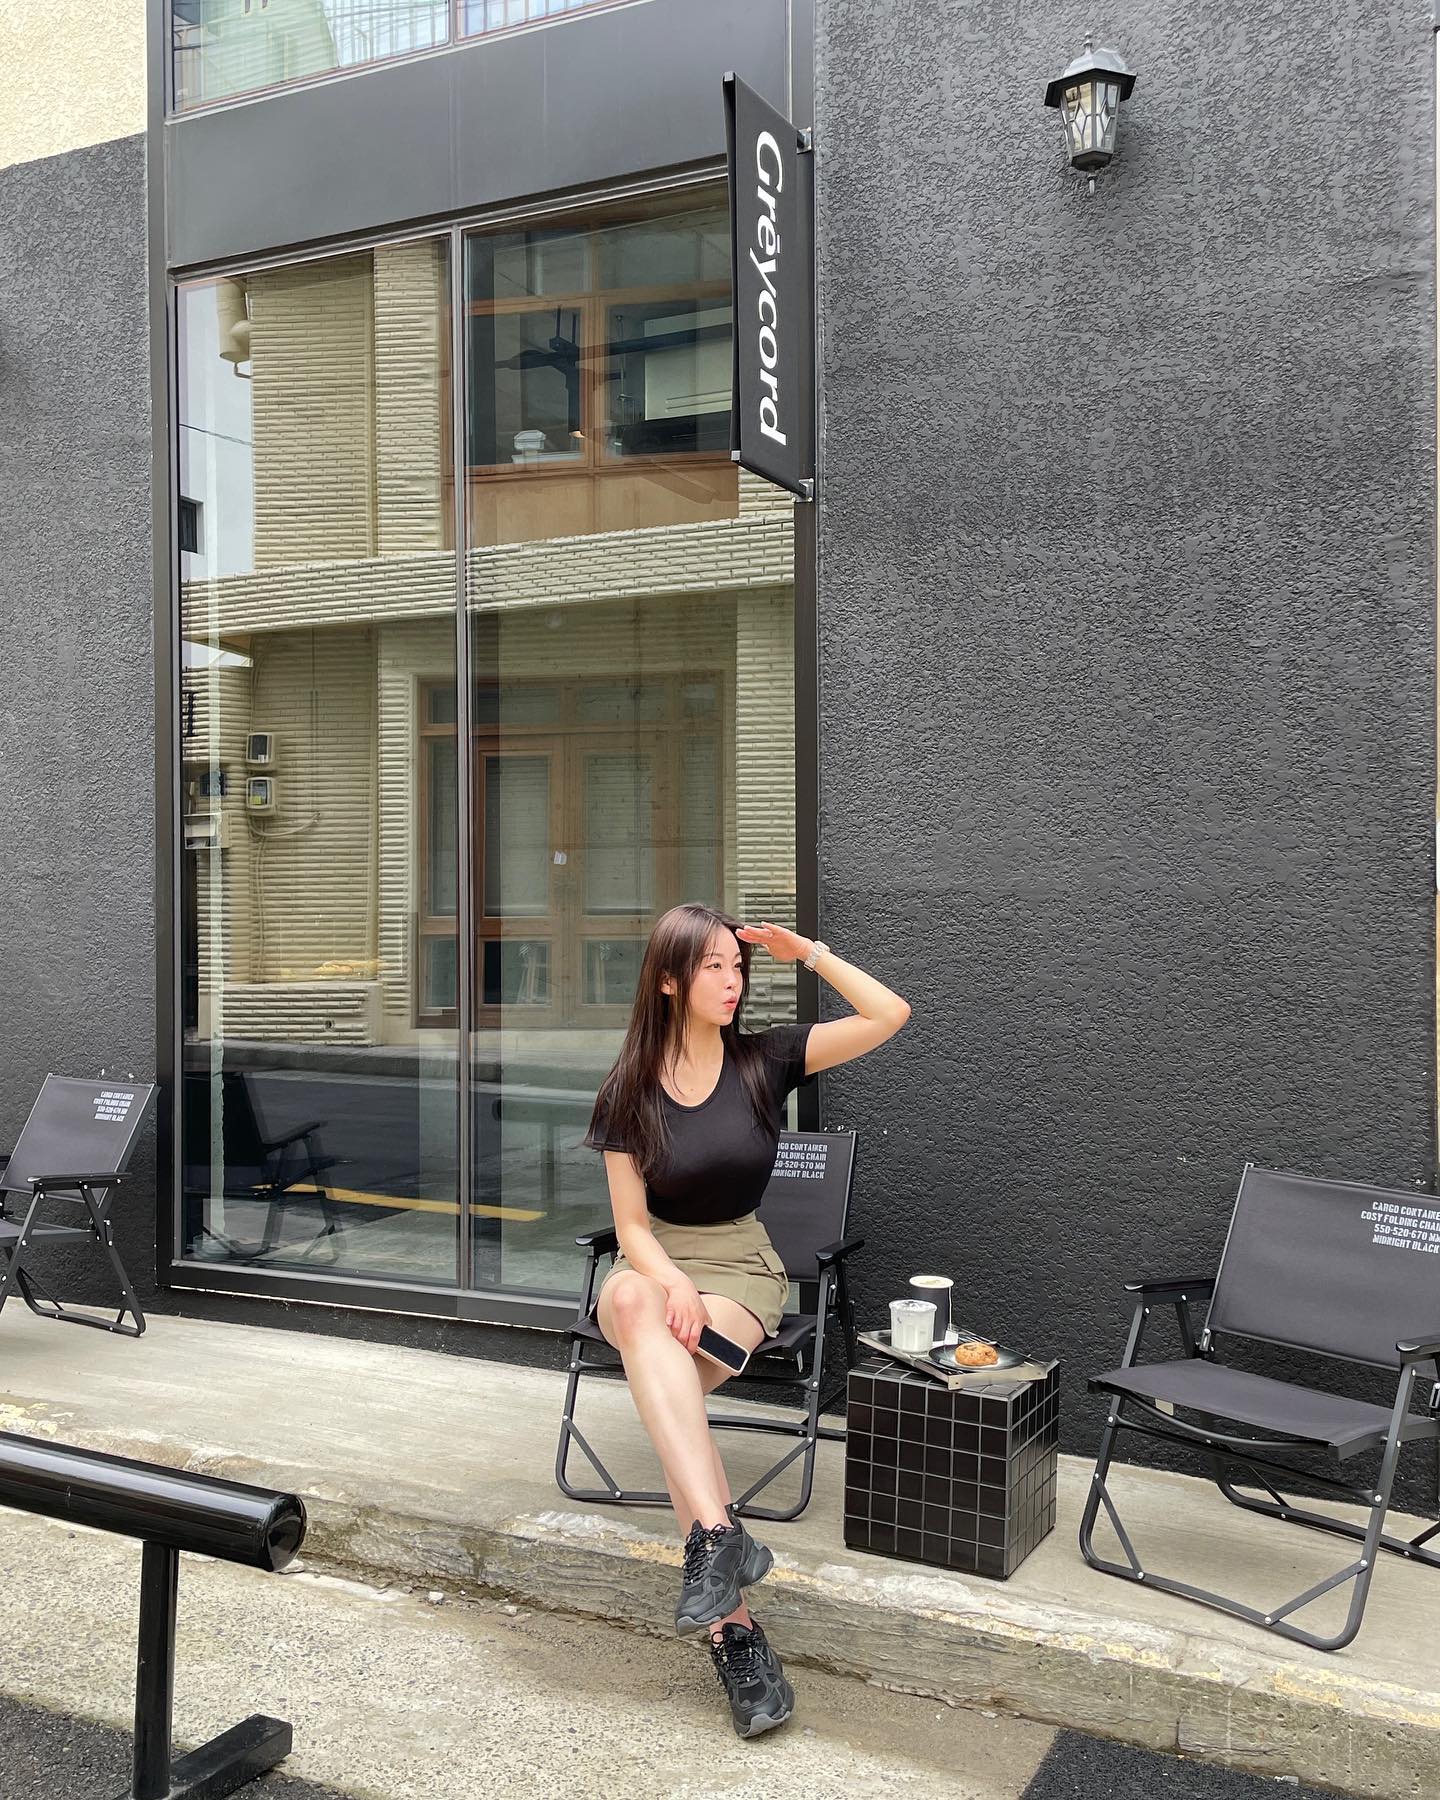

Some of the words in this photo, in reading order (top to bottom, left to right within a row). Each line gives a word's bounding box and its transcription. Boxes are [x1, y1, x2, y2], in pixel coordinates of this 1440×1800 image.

[790, 1143, 828, 1153] CONTAINER
[776, 1151, 805, 1160] FOLDING
[806, 1152, 827, 1161] CHAIR
[774, 1160, 814, 1170] 50-520-670
[801, 1170, 825, 1179] BLACK
[1372, 1201, 1400, 1214] CARGO
[1400, 1206, 1440, 1220] CONTAINE
[1361, 1210, 1383, 1222] COSY
[1383, 1214, 1418, 1228] FOLDING
[1419, 1220, 1440, 1232] CHAI
[1373, 1223, 1428, 1241] 550-520-670
[1372, 1234, 1412, 1249] MIDNIGHT
[1411, 1240, 1440, 1254] BLACK
